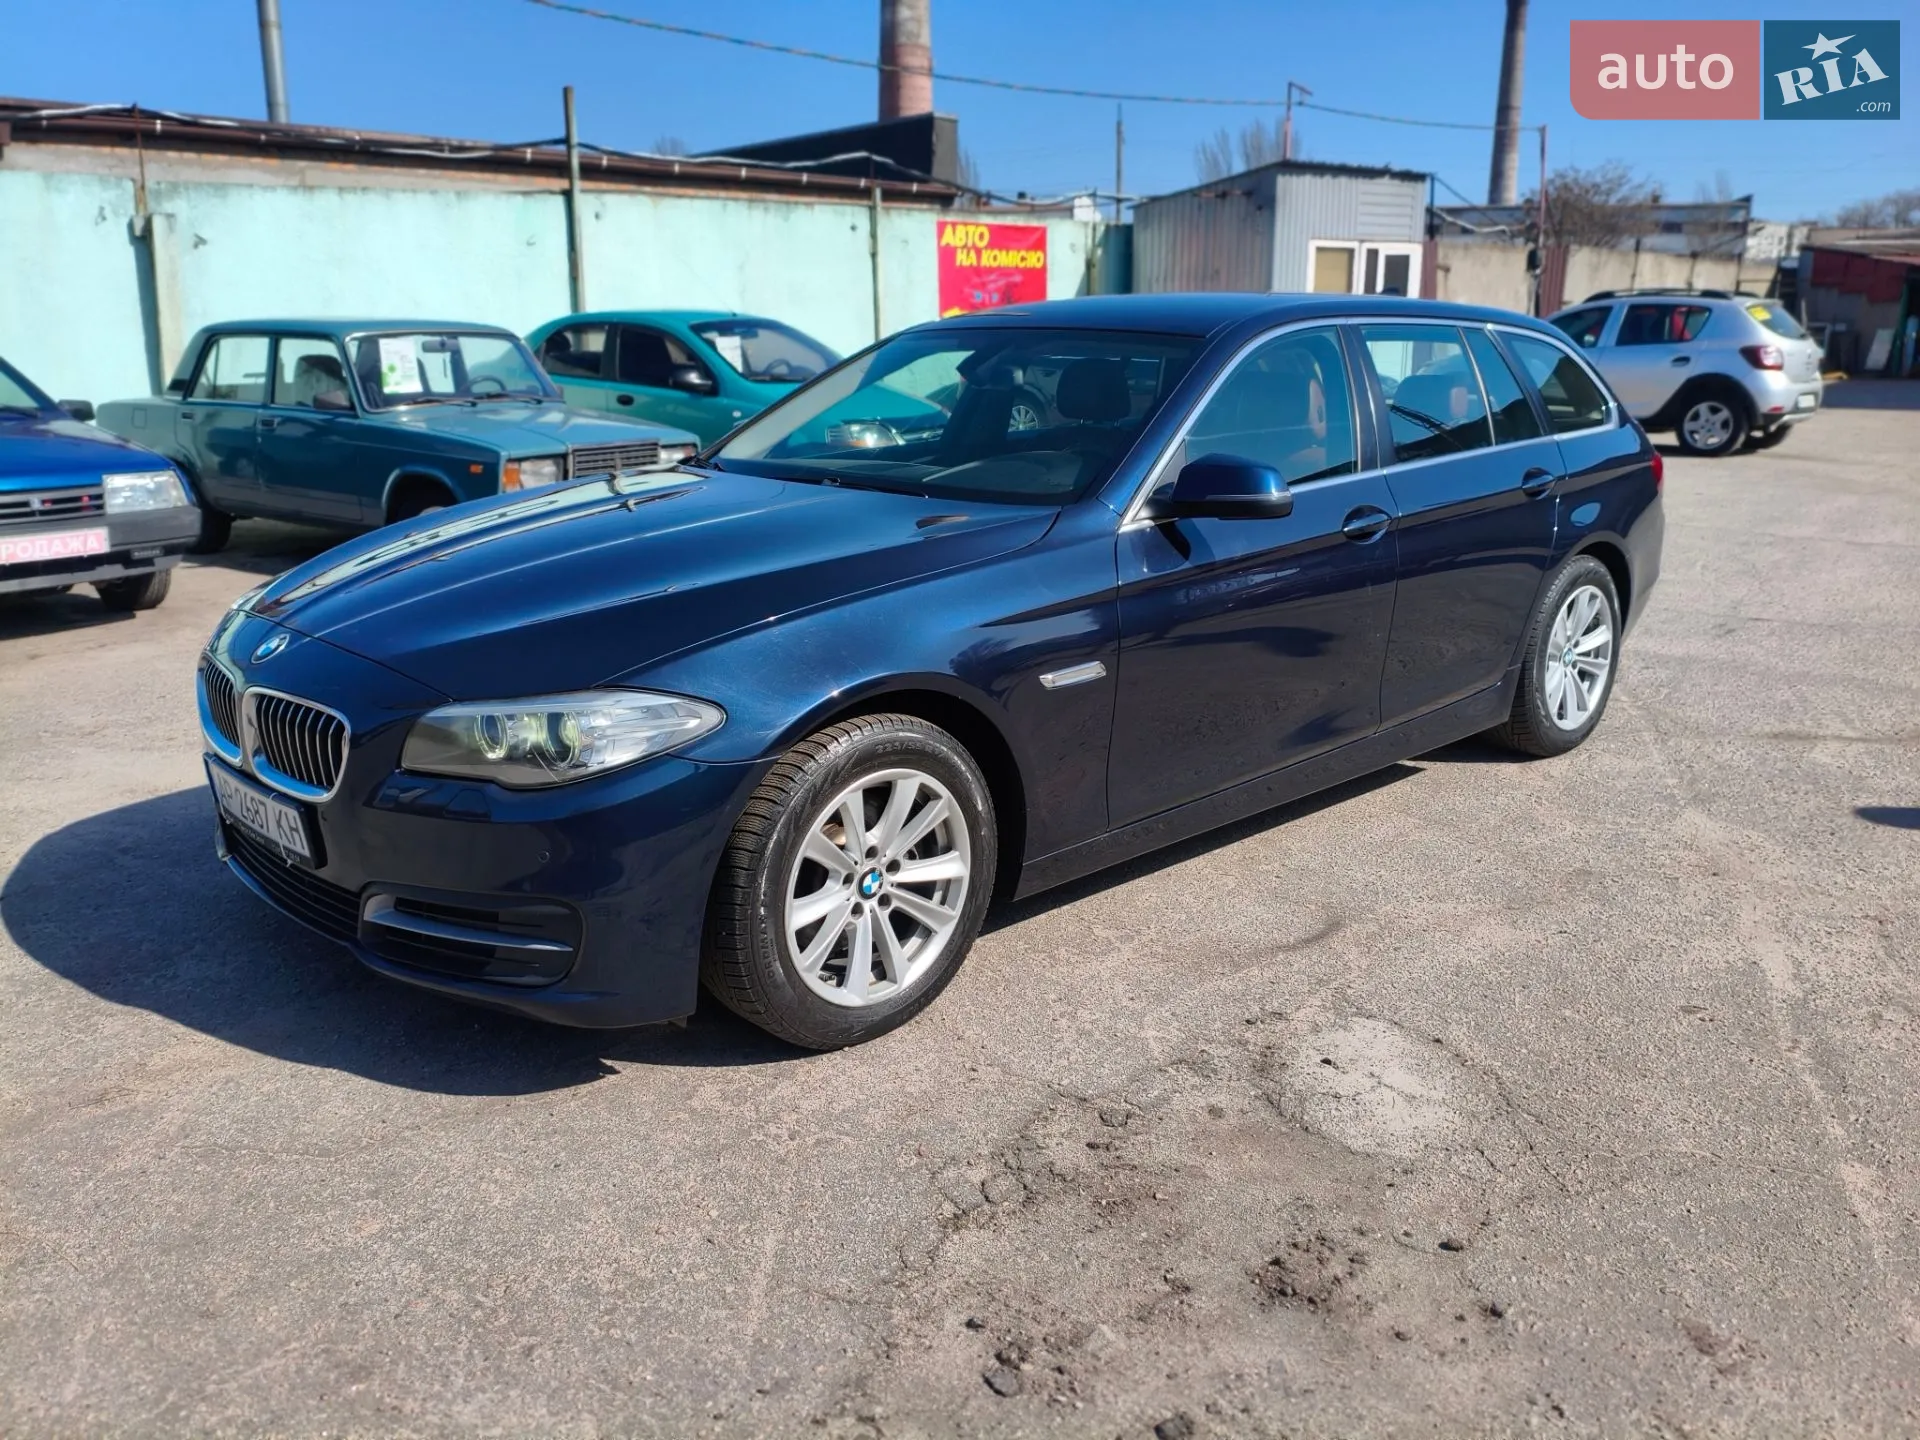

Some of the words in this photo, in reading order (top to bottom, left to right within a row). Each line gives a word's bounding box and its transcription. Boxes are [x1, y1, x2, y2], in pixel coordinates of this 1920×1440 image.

[940, 224, 990, 248] АВТО
[956, 249, 977, 267] НА
[981, 249, 1045, 269] КОМІСІЮ
[273, 806, 306, 851] KH
